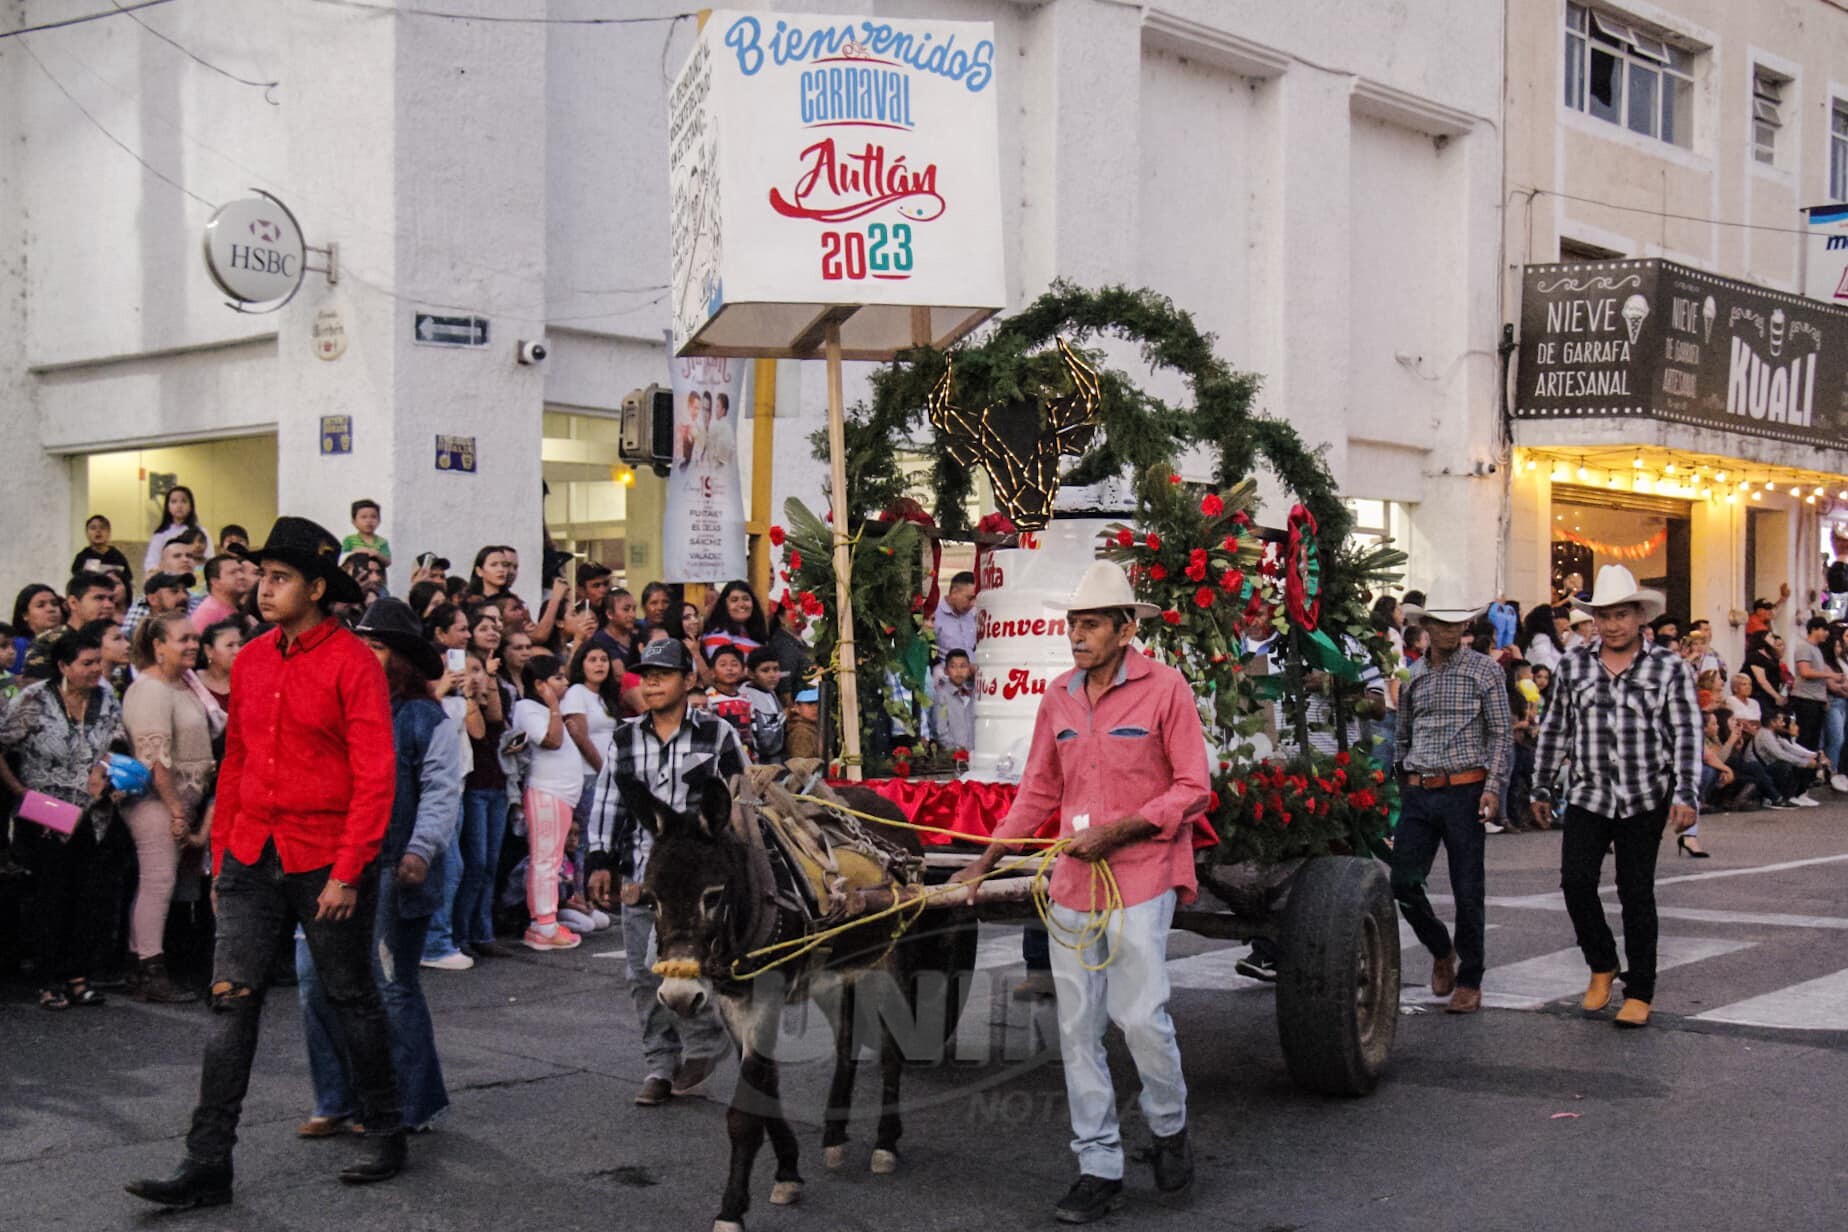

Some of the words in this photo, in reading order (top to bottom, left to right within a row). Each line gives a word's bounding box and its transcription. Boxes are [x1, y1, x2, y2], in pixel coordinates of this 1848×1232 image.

[725, 16, 994, 93] Bienvenidos
[795, 137, 938, 199] Autlán
[230, 243, 297, 279] HSBC
[821, 223, 914, 281] 2023
[1546, 298, 1618, 334] NIEVE
[1536, 342, 1556, 365] DE
[1562, 339, 1632, 364] GARRAFA
[1534, 369, 1633, 398] ARTESANAL
[1725, 335, 1817, 428] KUALI
[976, 608, 1068, 644] Bienven
[1002, 667, 1047, 701] Au
